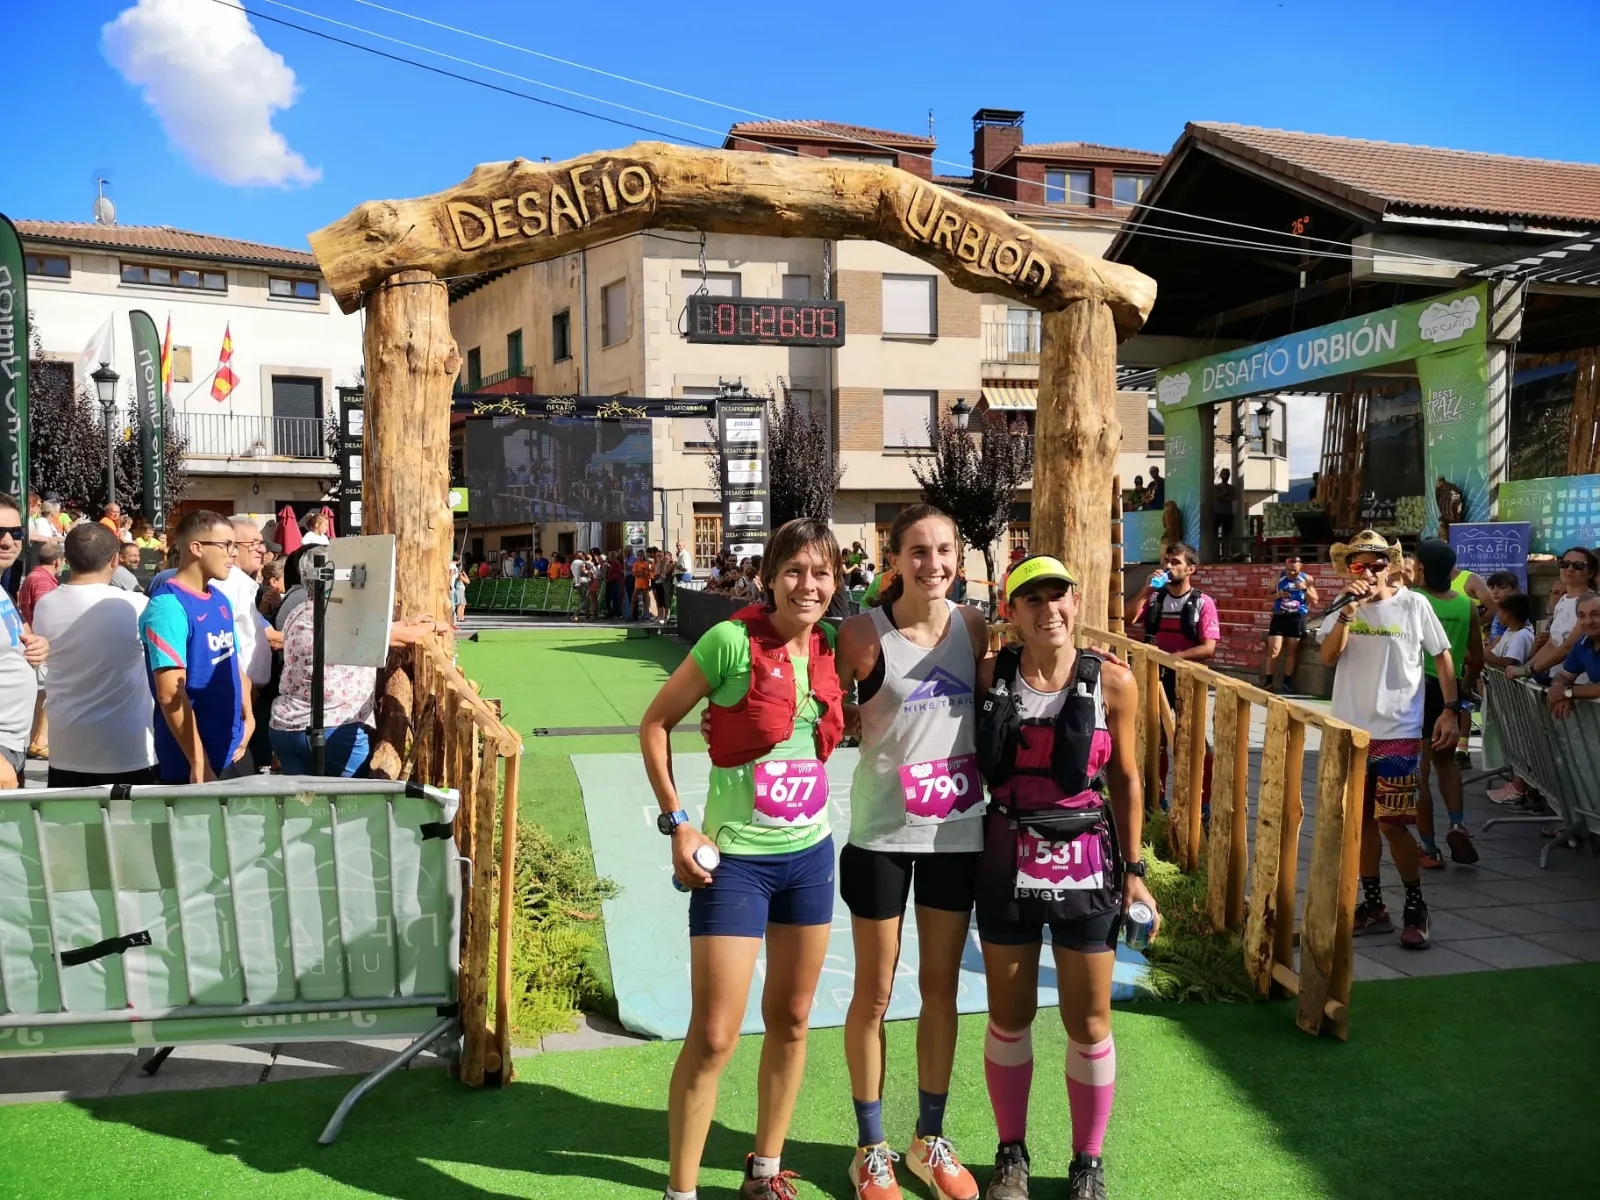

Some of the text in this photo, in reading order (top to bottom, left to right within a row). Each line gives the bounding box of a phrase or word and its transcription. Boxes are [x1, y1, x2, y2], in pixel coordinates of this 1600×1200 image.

[446, 160, 1052, 296] DESAFÍO URBIÓN
[1202, 318, 1398, 393] DESAFÍO URBIÓN
[1432, 389, 1453, 399] BEST
[904, 696, 974, 713] NIKE TRAIL
[770, 776, 818, 803] 677
[918, 772, 969, 804] 790
[1035, 840, 1082, 865] 531
